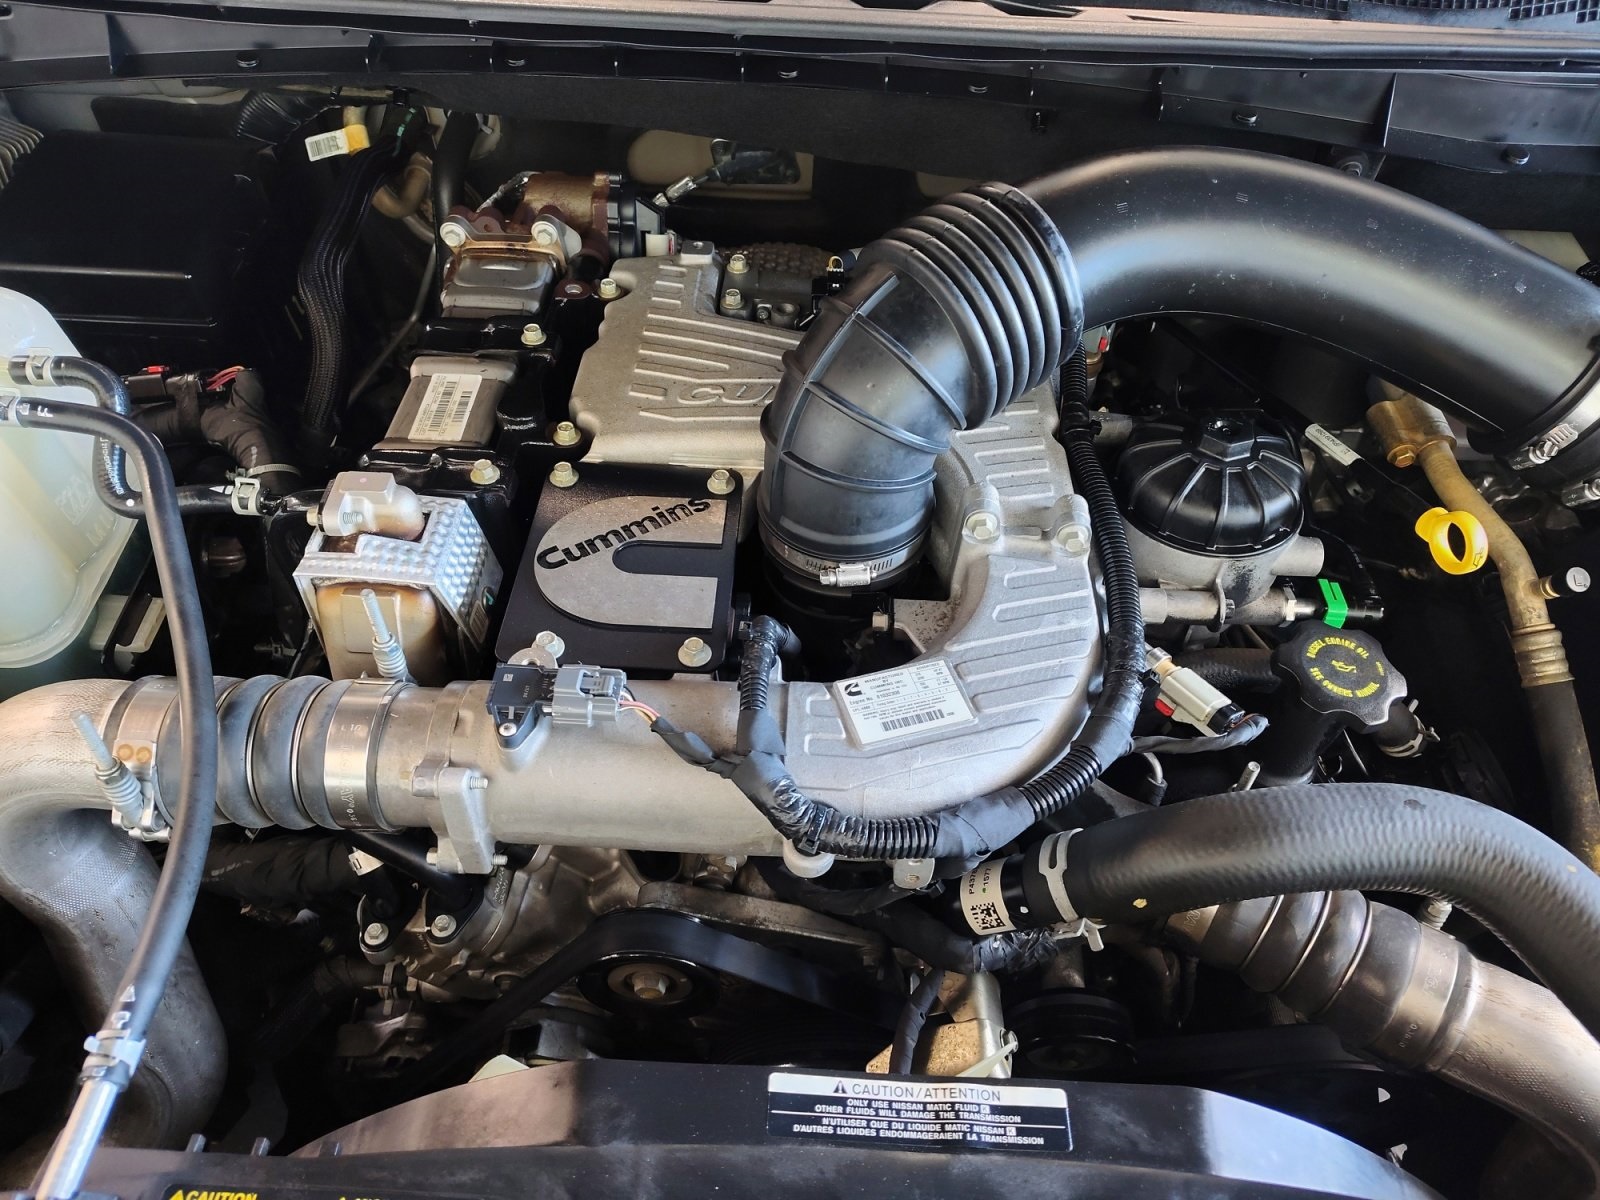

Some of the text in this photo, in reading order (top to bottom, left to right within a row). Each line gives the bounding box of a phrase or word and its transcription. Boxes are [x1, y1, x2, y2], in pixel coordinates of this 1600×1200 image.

[536, 497, 712, 570] Cummins
[1324, 637, 1356, 649] ENGINE
[1355, 646, 1370, 659] OIL
[1309, 667, 1325, 681] SEE
[814, 1104, 1021, 1123] OTHER FLUIDS WILL DAMAGE THE TRANSMISSION
[847, 1098, 870, 1107] ONLY
[872, 1100, 889, 1109] USE
[892, 1101, 924, 1111] NISSAN
[926, 1103, 952, 1111] MATIC
[955, 1103, 979, 1112] FLUID
[793, 1123, 1045, 1145] D'AUTRES LIQUIDES ENDOMMAGERAIENT LA TRANSMISSION
[822, 1117, 867, 1128] N'UTILISER
[869, 1120, 889, 1129] QUE
[891, 1121, 905, 1130] DU
[907, 1122, 941, 1132] LIQUIDE
[944, 1123, 971, 1132] MATIC
[973, 1125, 1005, 1135] NISSAN
